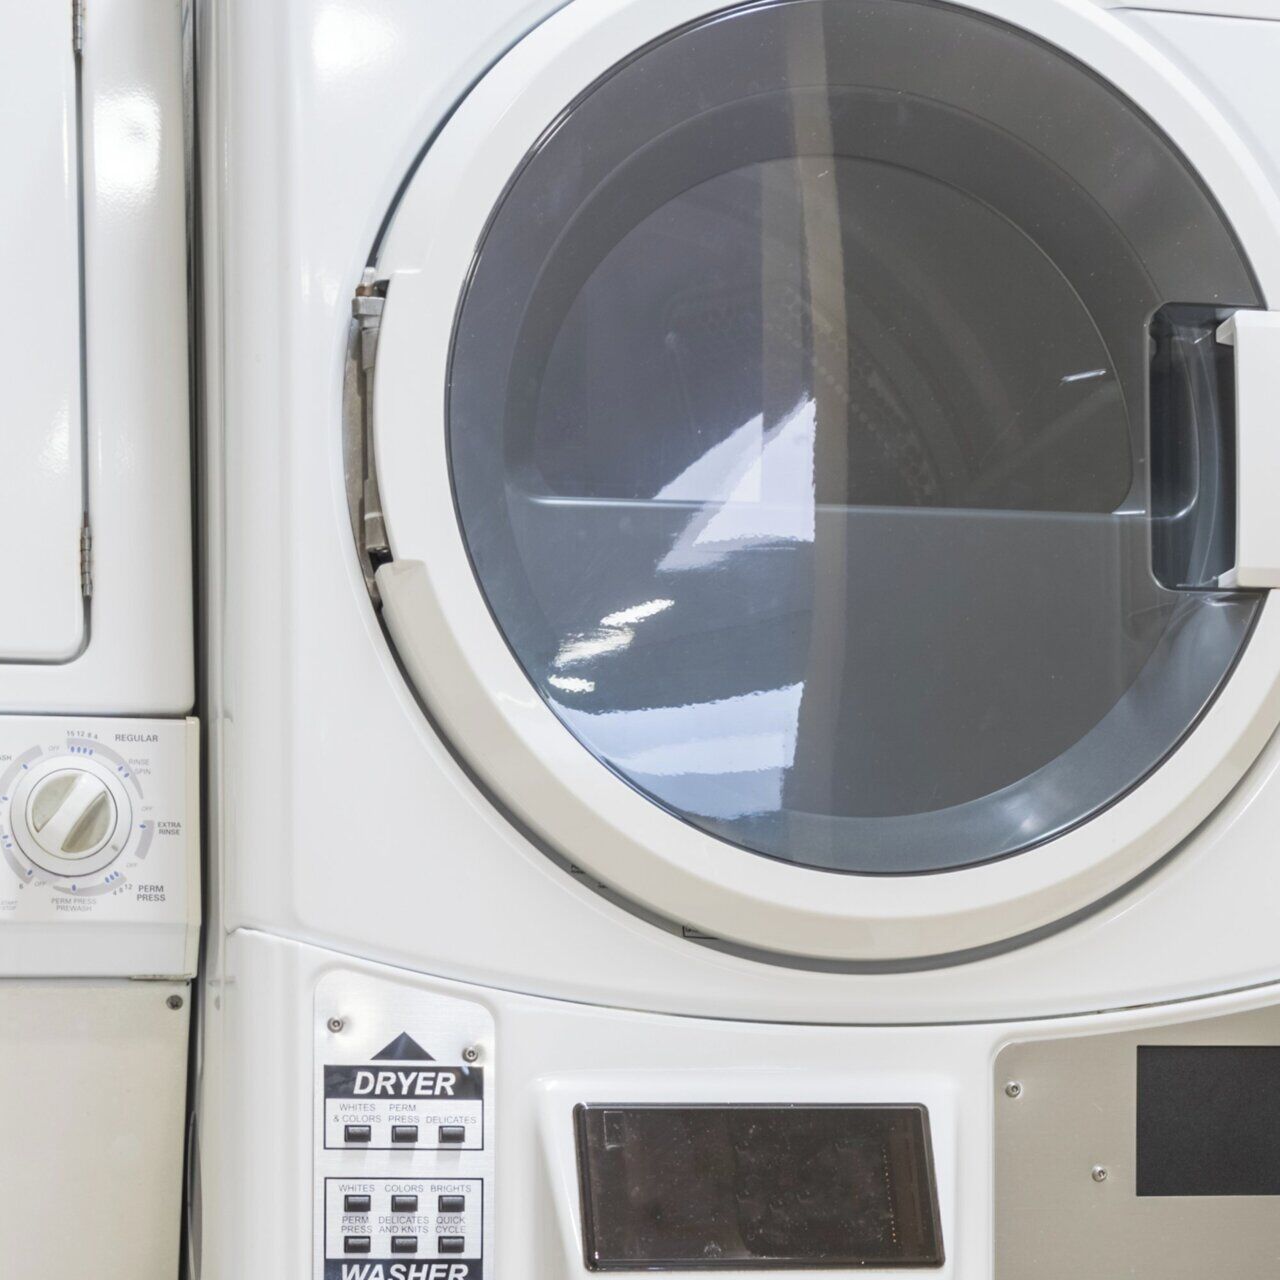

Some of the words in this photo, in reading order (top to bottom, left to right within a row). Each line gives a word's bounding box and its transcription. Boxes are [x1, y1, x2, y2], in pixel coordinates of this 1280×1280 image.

[115, 734, 159, 742] REGULAR
[138, 885, 164, 893] PERM
[137, 894, 166, 902] PRESS
[353, 1071, 457, 1096] DRYER
[339, 1104, 376, 1112] WHITES
[389, 1104, 416, 1112] PERM
[342, 1115, 382, 1123] COLORS
[426, 1116, 477, 1124] DELICATES
[342, 1216, 369, 1224] PERM
[378, 1216, 429, 1224] DELICATES
[436, 1216, 466, 1224] QUICK
